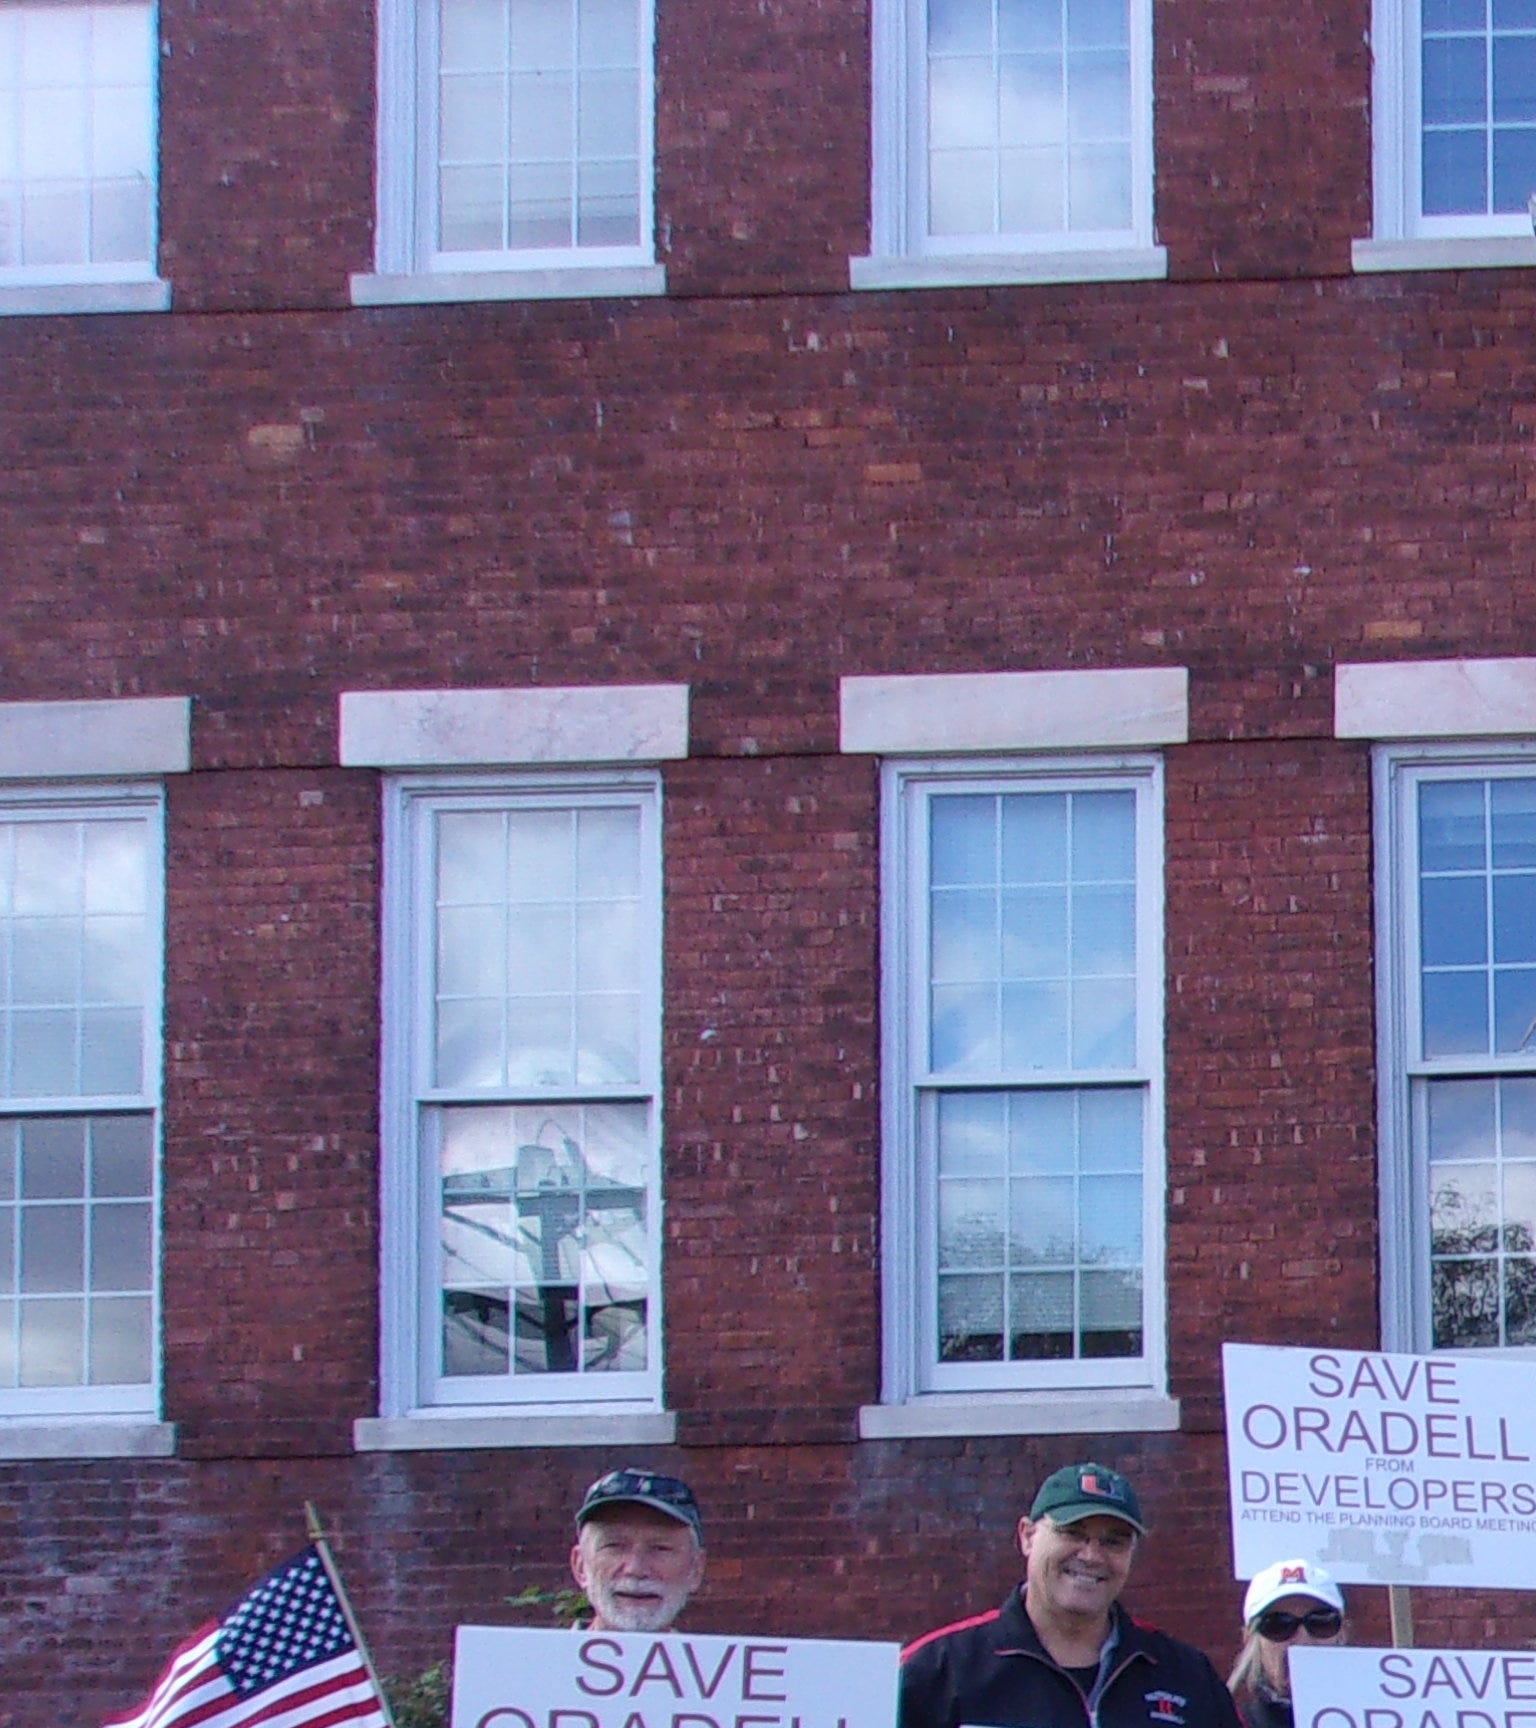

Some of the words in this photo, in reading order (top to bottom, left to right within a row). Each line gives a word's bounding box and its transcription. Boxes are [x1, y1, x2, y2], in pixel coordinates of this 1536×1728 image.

[1309, 1354, 1460, 1404] SAVE
[1242, 1404, 1530, 1462] ORADELL
[1365, 1457, 1415, 1473] FROM
[1241, 1509, 1301, 1523] ATTEND
[1305, 1511, 1336, 1525] THE
[1339, 1512, 1416, 1528] PLANNING
[1420, 1515, 1472, 1530] BOARD
[575, 1638, 788, 1701] SAVE
